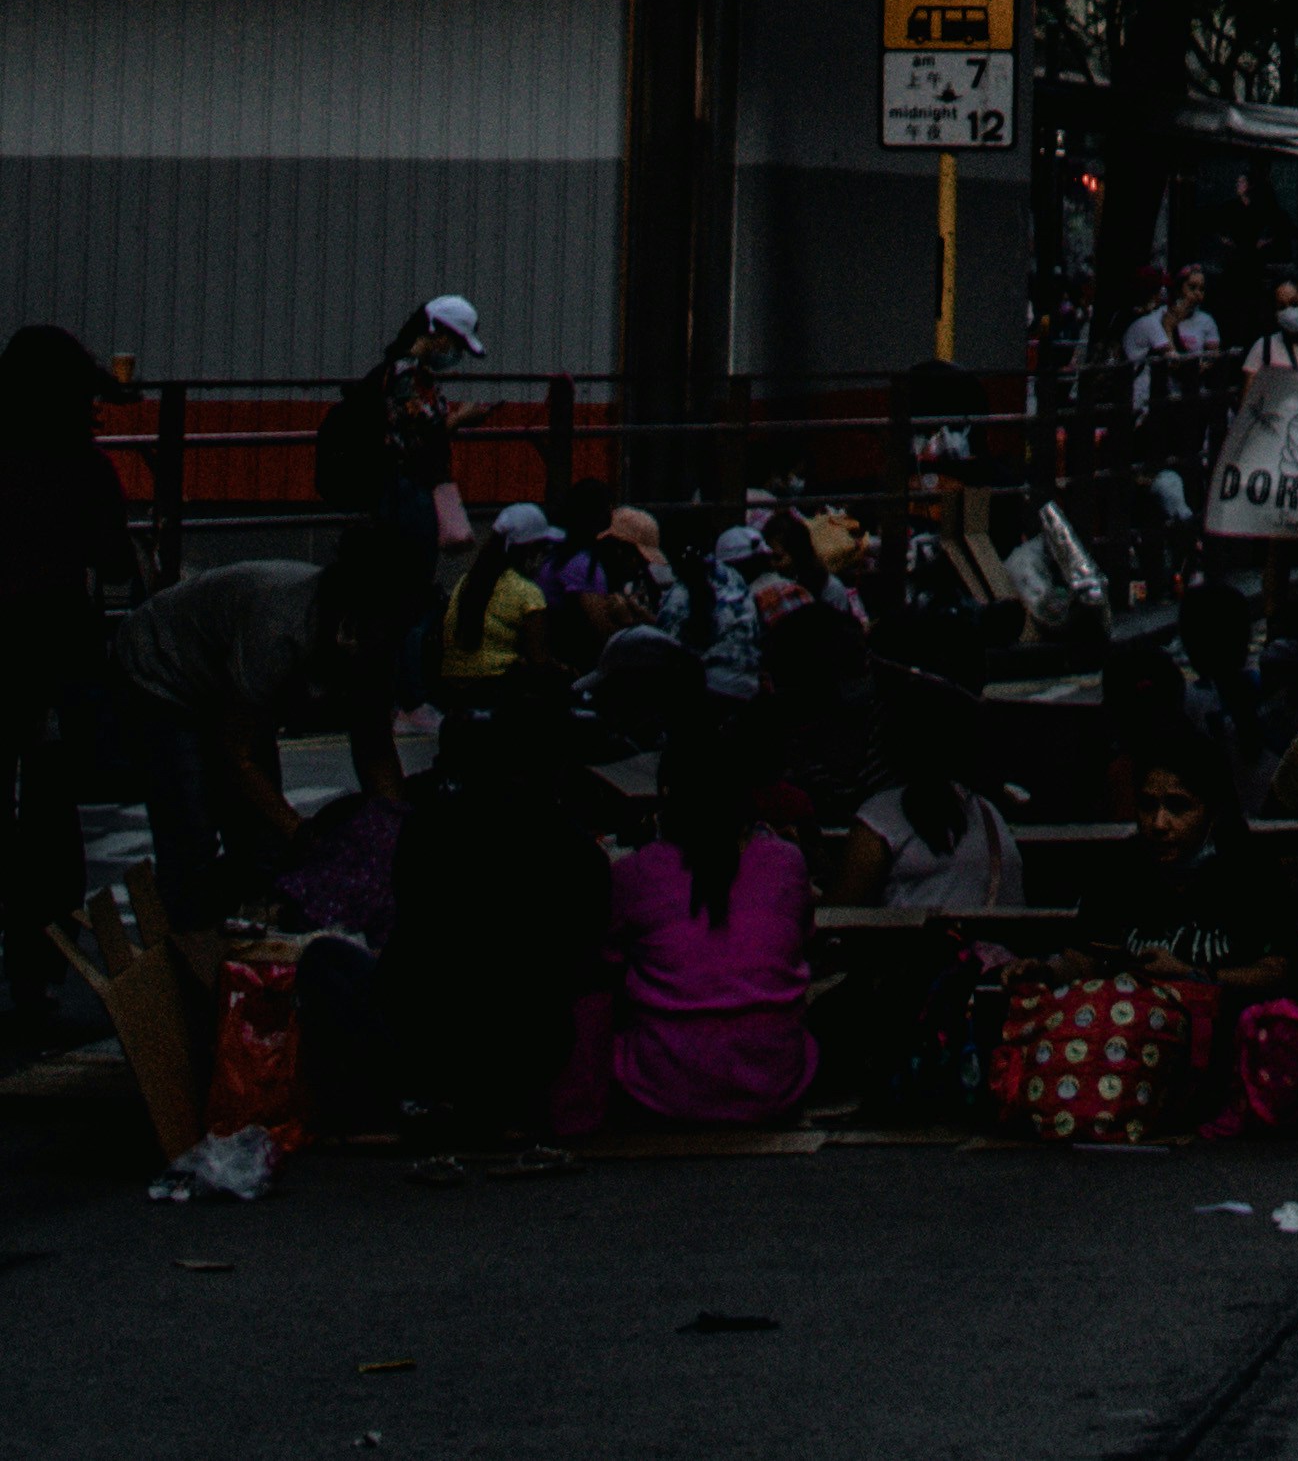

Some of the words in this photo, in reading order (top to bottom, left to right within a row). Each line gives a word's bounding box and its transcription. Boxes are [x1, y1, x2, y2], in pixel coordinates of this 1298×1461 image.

[912, 56, 936, 67] am
[966, 58, 989, 88] 7
[889, 106, 958, 123] midnight
[968, 109, 1005, 141] 12
